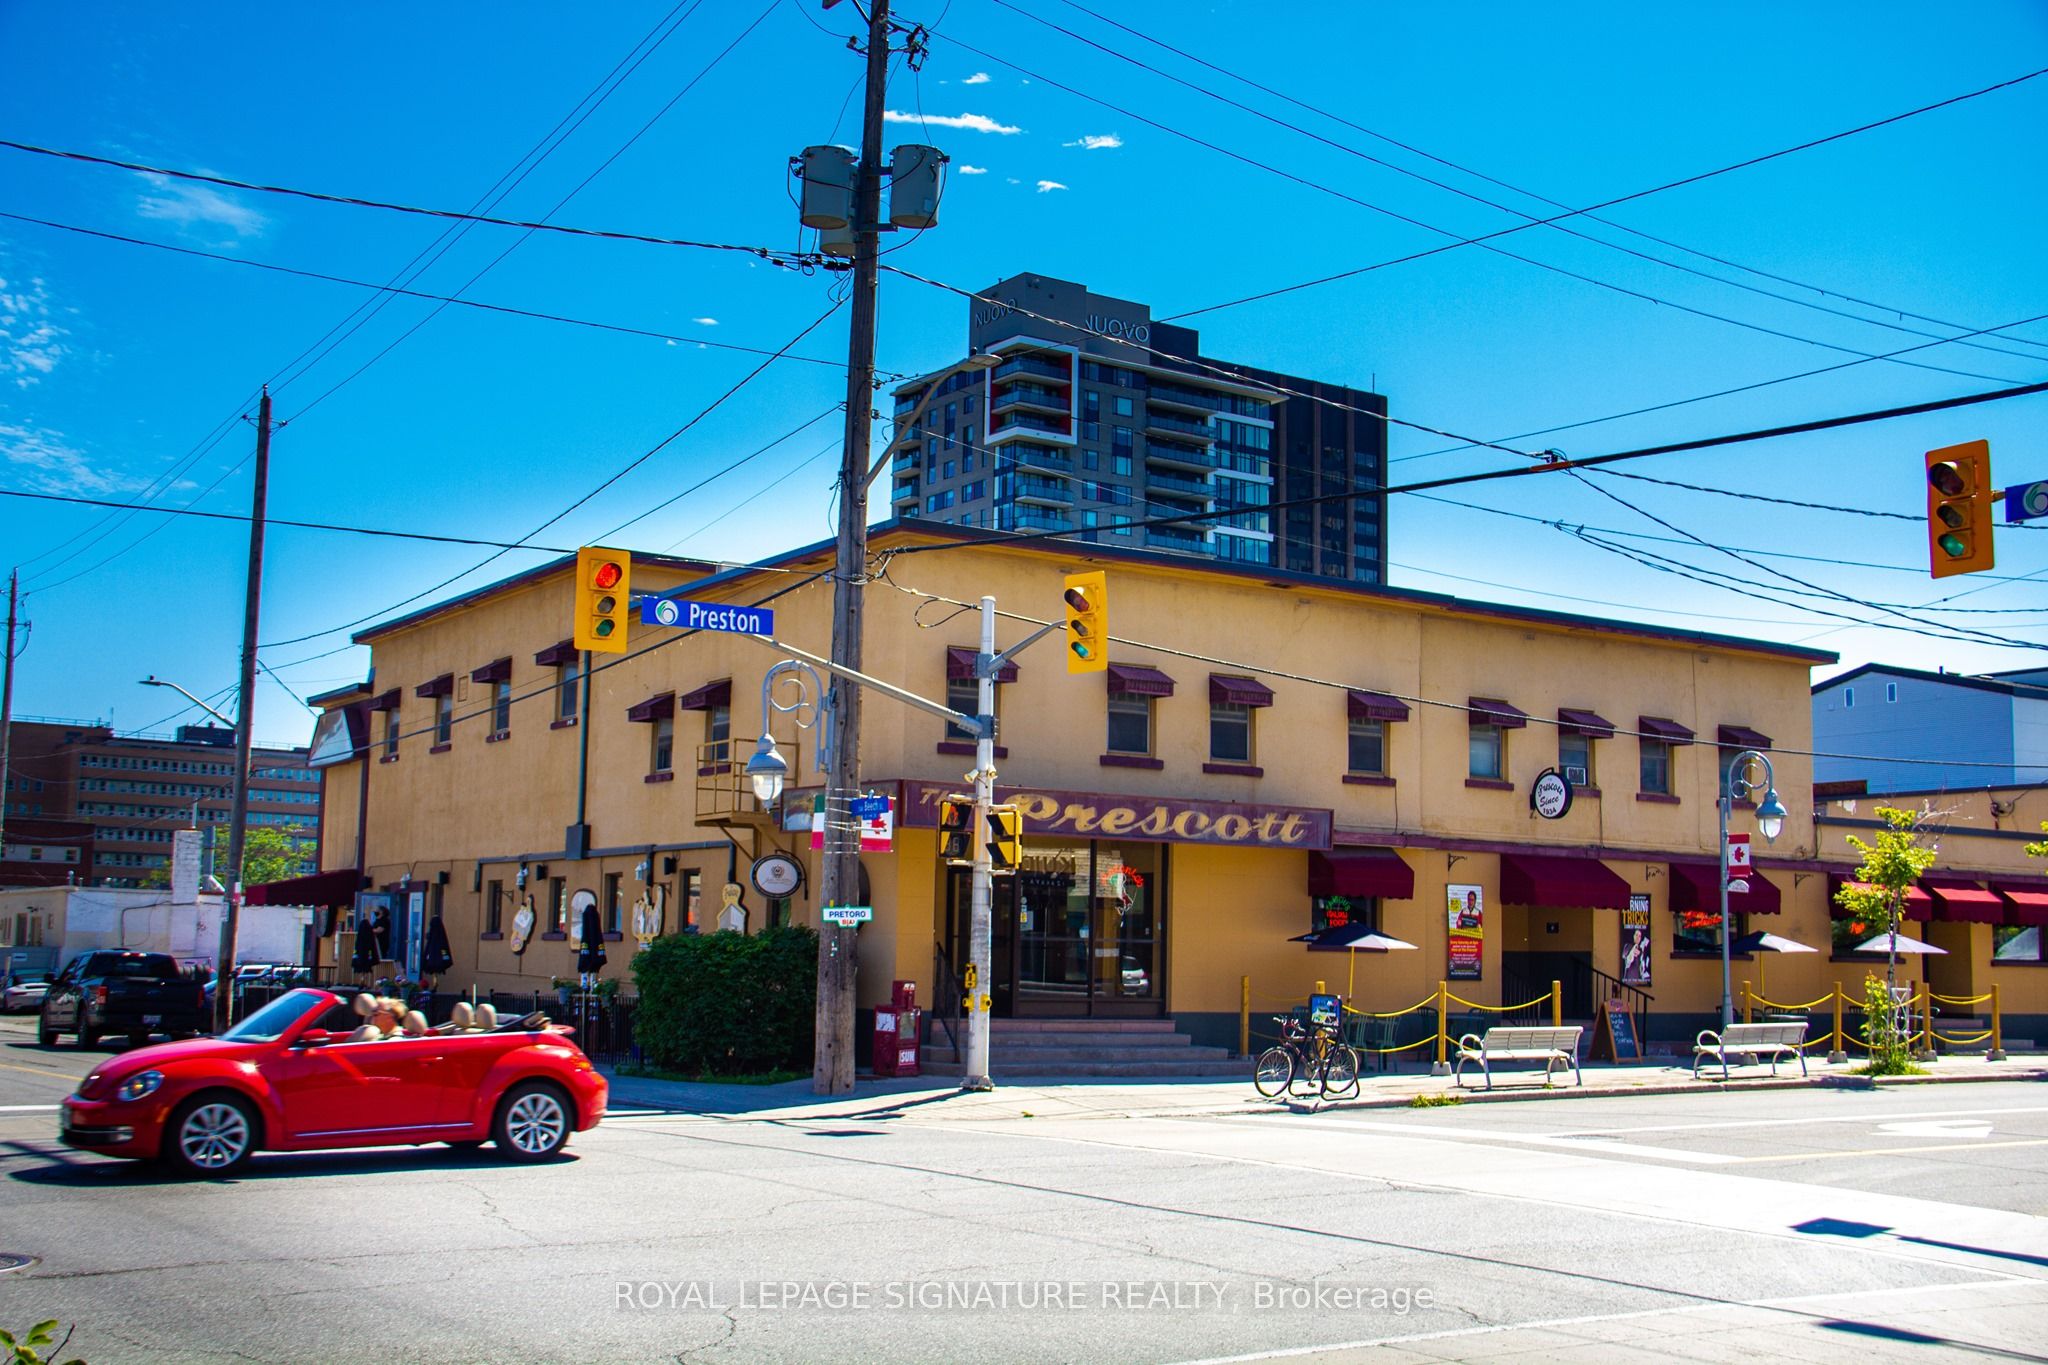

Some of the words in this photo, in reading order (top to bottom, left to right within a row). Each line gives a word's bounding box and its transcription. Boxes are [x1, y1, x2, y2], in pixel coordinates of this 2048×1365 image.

[975, 298, 1018, 328] NUOVO
[1085, 314, 1150, 343] NUOVO
[689, 603, 760, 633] Preston
[1539, 796, 1559, 807] Since
[1002, 793, 1313, 843] Prescott
[1629, 899, 1649, 912] RNING
[828, 910, 866, 918] PRETORO
[1623, 910, 1649, 926] TRICKS
[901, 1050, 915, 1063] SUN
